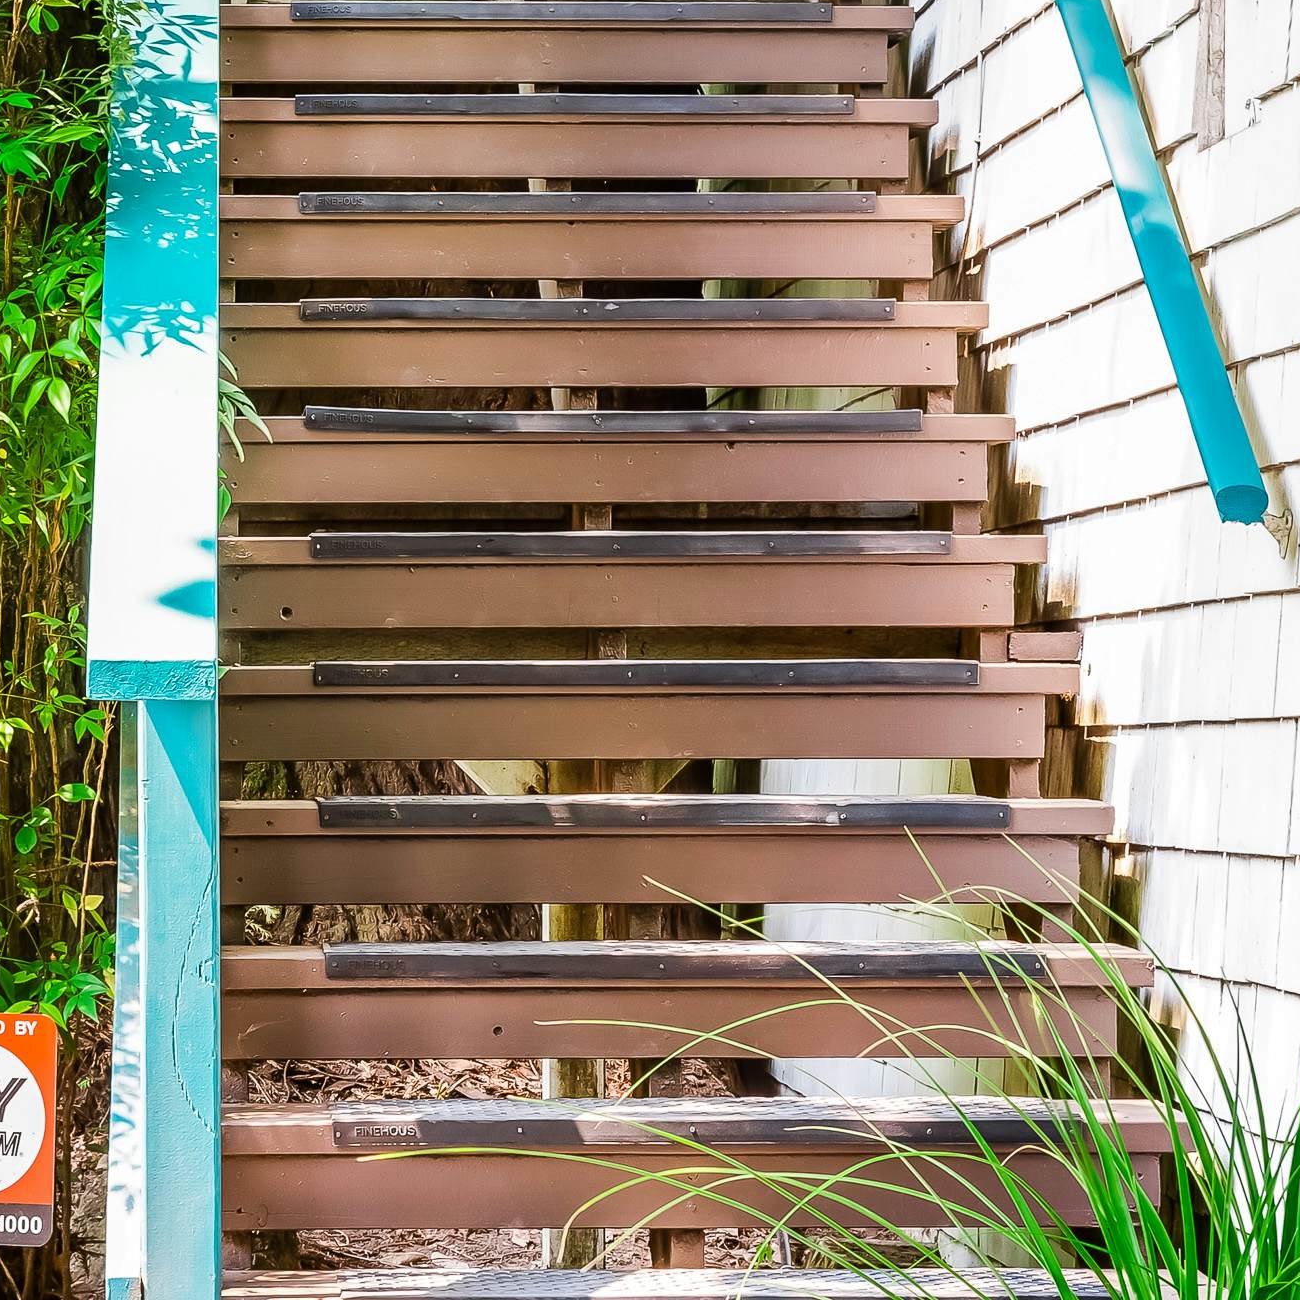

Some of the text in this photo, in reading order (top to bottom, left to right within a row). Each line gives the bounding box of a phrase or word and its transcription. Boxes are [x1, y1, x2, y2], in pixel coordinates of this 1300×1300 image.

[318, 304, 367, 314] FINEHOUS
[15, 1021, 37, 1036] BY
[353, 1126, 416, 1137] FINEHOUS
